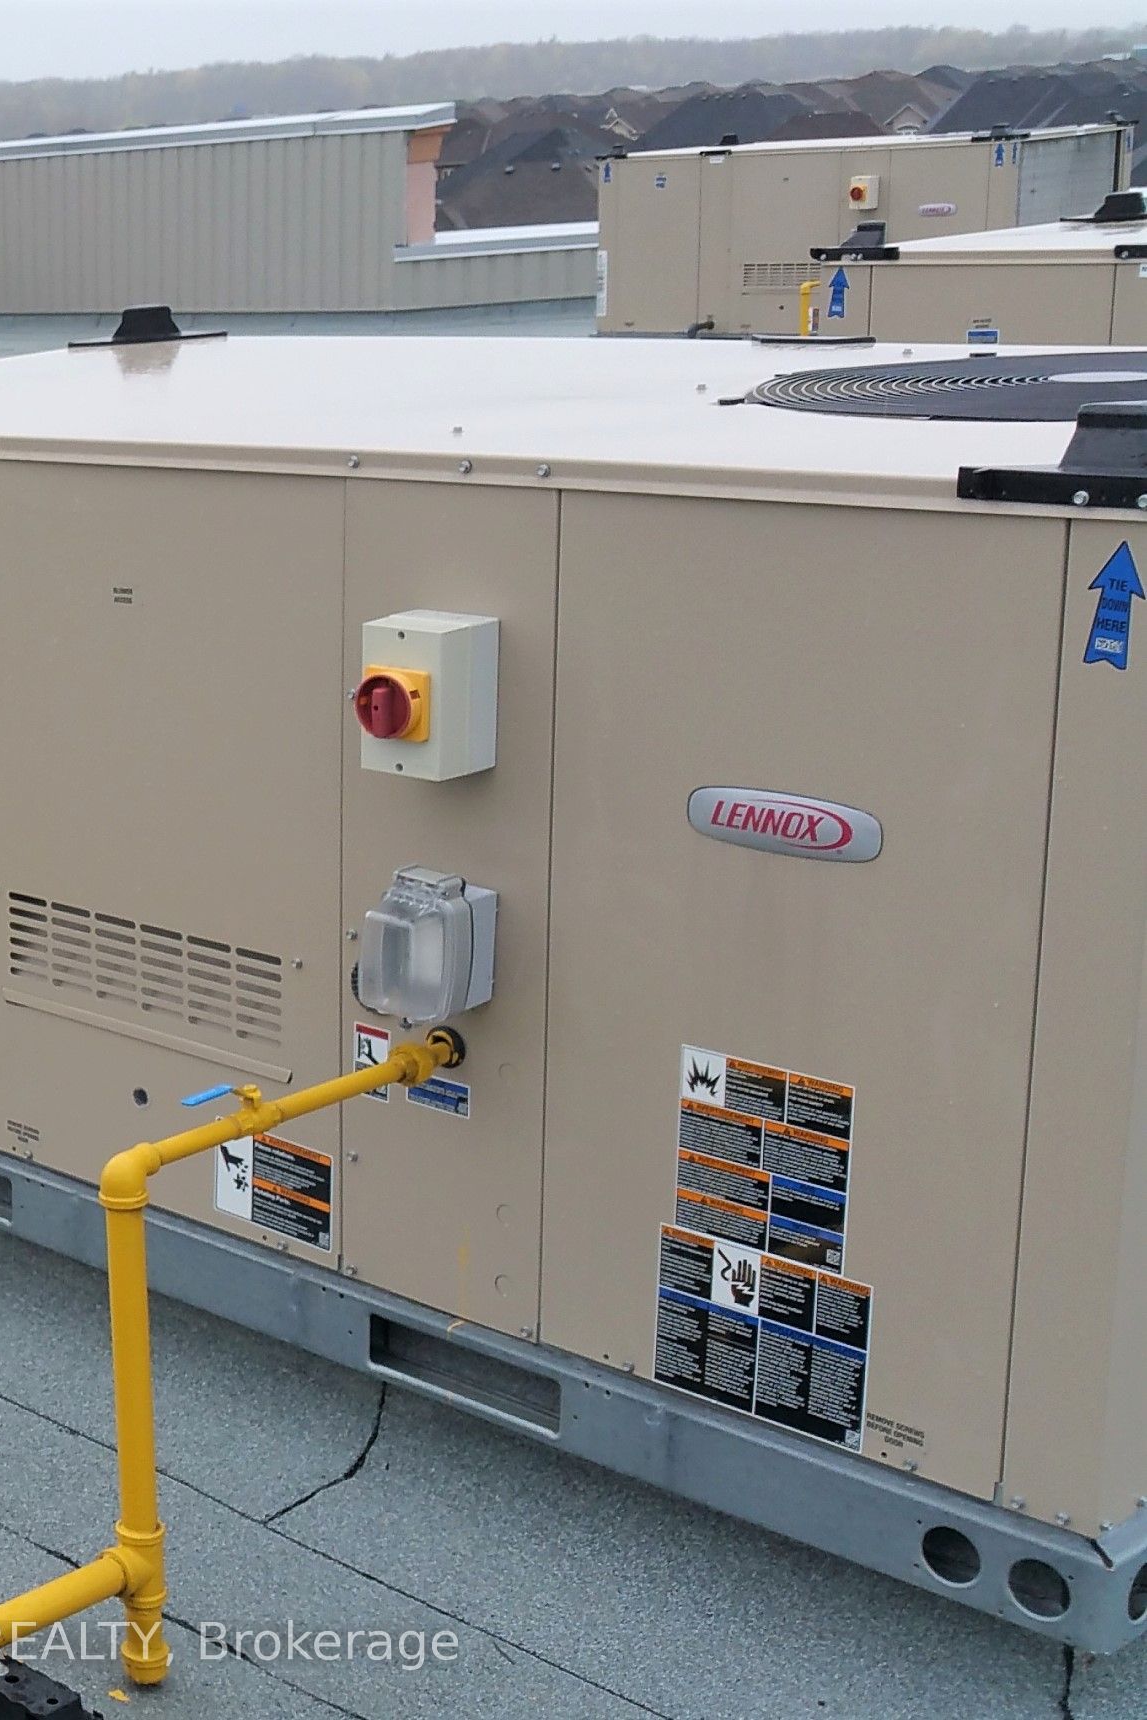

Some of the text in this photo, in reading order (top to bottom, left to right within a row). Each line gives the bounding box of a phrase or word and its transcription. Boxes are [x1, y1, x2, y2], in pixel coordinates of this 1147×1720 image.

[1108, 578, 1128, 592] TIE
[1101, 597, 1129, 613] DOWN
[1095, 618, 1127, 633] HERE
[710, 800, 825, 842] LENNOX
[866, 1412, 895, 1427] REMOVE
